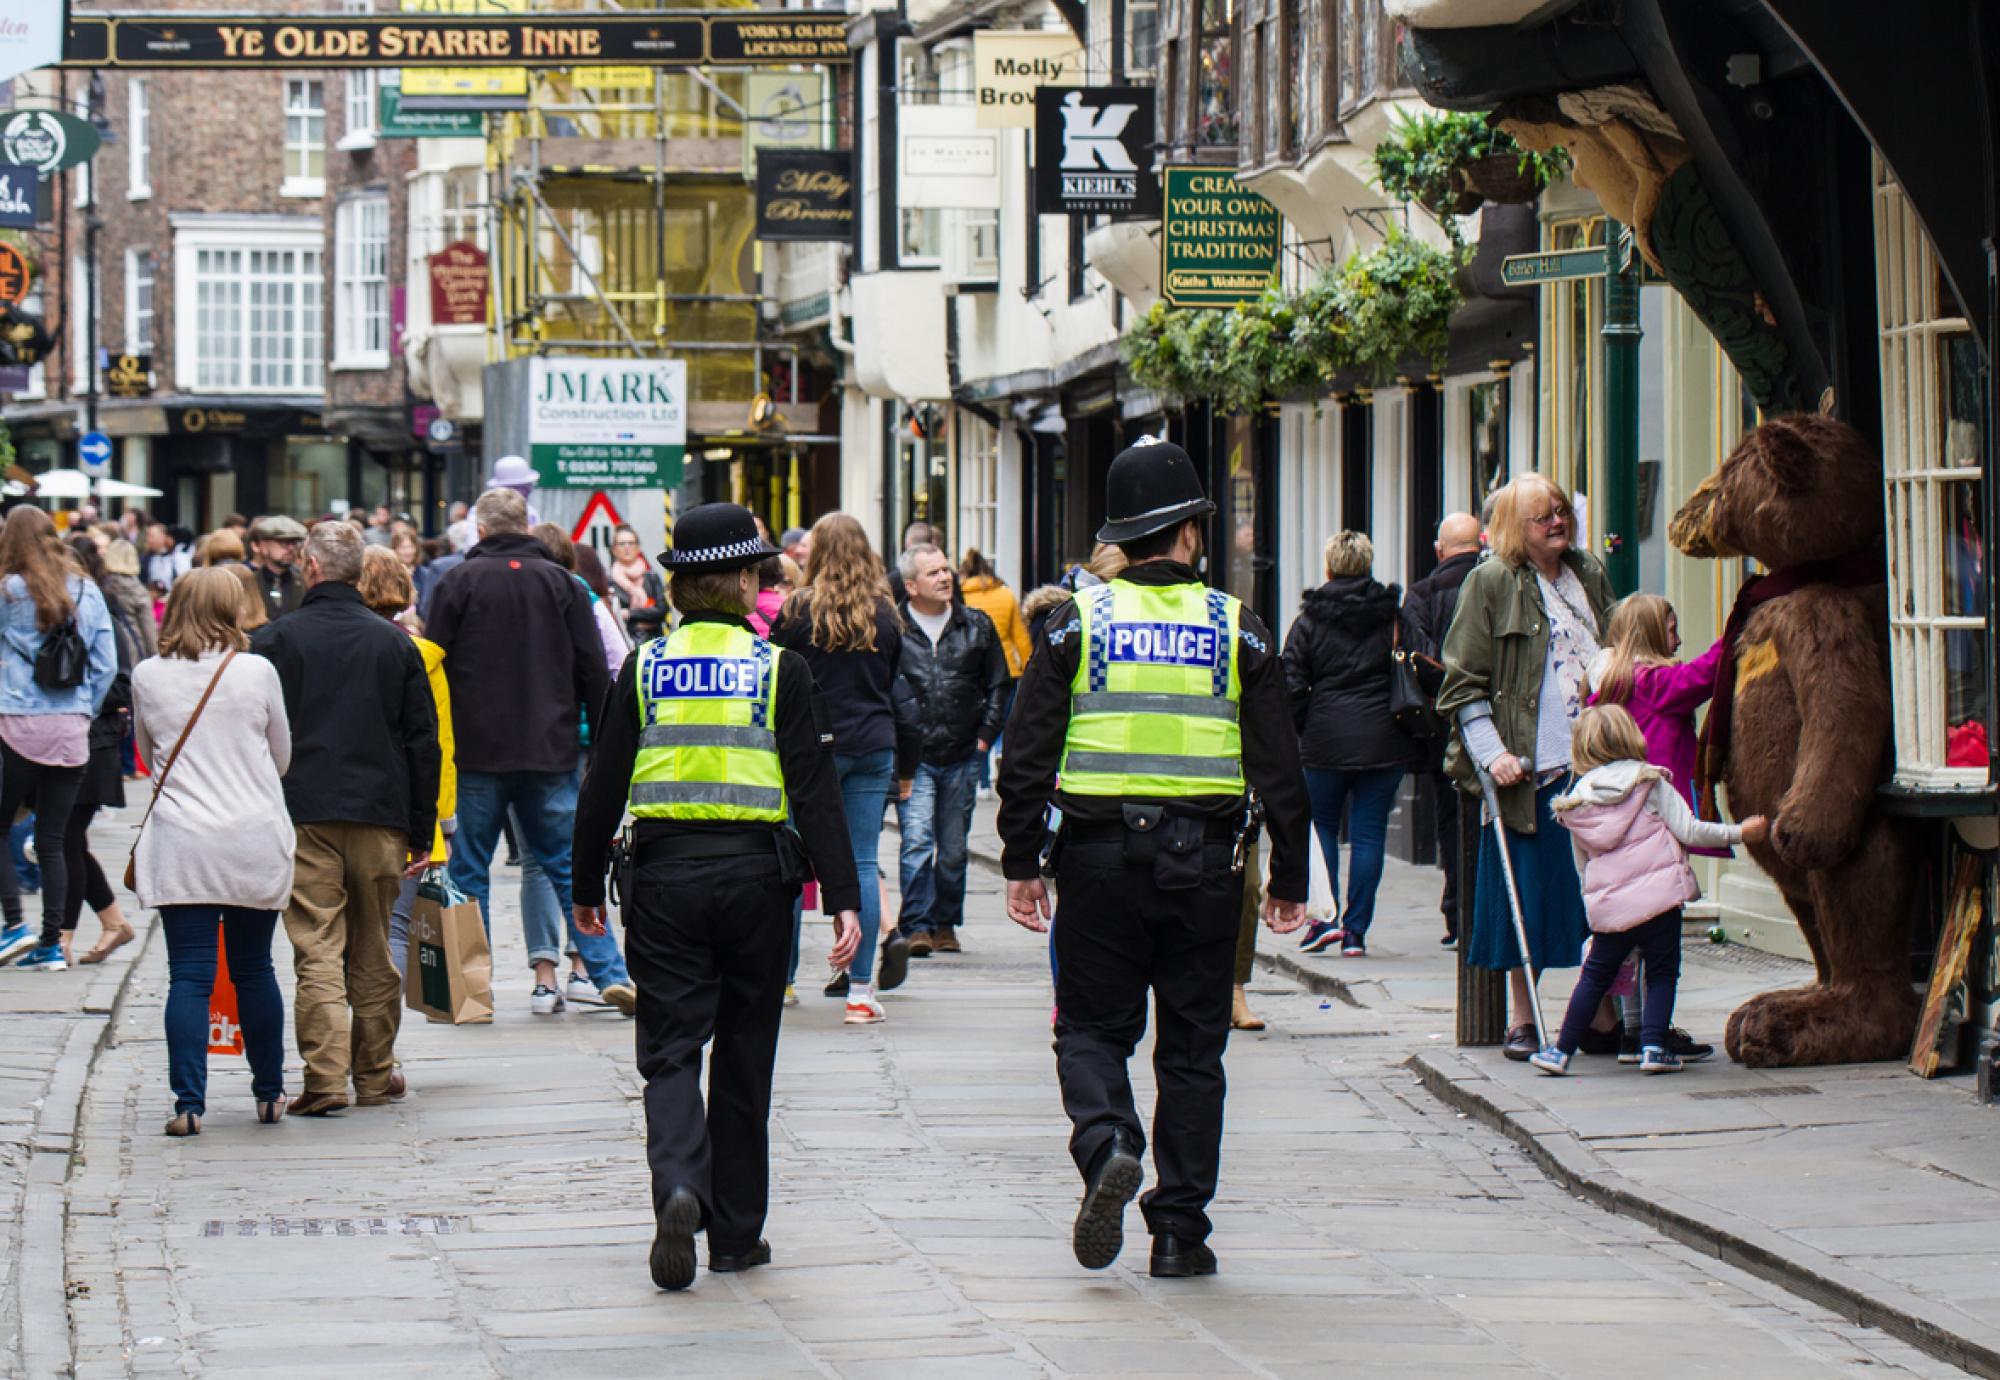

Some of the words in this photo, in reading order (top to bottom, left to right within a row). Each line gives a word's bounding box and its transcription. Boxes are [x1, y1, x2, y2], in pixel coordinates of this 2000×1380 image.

[737, 24, 791, 39] YORK'S
[795, 24, 846, 38] OLDES
[217, 26, 264, 56] YE
[275, 26, 370, 56] OLDE
[378, 26, 511, 56] STARRE
[521, 27, 601, 56] INNE
[744, 41, 818, 56] LICENSED
[821, 42, 848, 55] INN
[994, 58, 1063, 80] Molly
[776, 169, 850, 199] Molly
[1064, 177, 1137, 194] KIEHL'S
[1171, 198, 1224, 215] YOUR
[1227, 199, 1274, 215] OWN
[1169, 220, 1275, 237] CHRISTMAS
[1170, 242, 1273, 259] TRADITION
[1540, 255, 1561, 273] Hall
[537, 370, 673, 404] JMARK
[537, 406, 646, 421] Construction
[651, 408, 678, 421] Ltd
[1114, 629, 1213, 660] POLICE
[656, 663, 755, 692] POLICE
[420, 946, 437, 968] an
